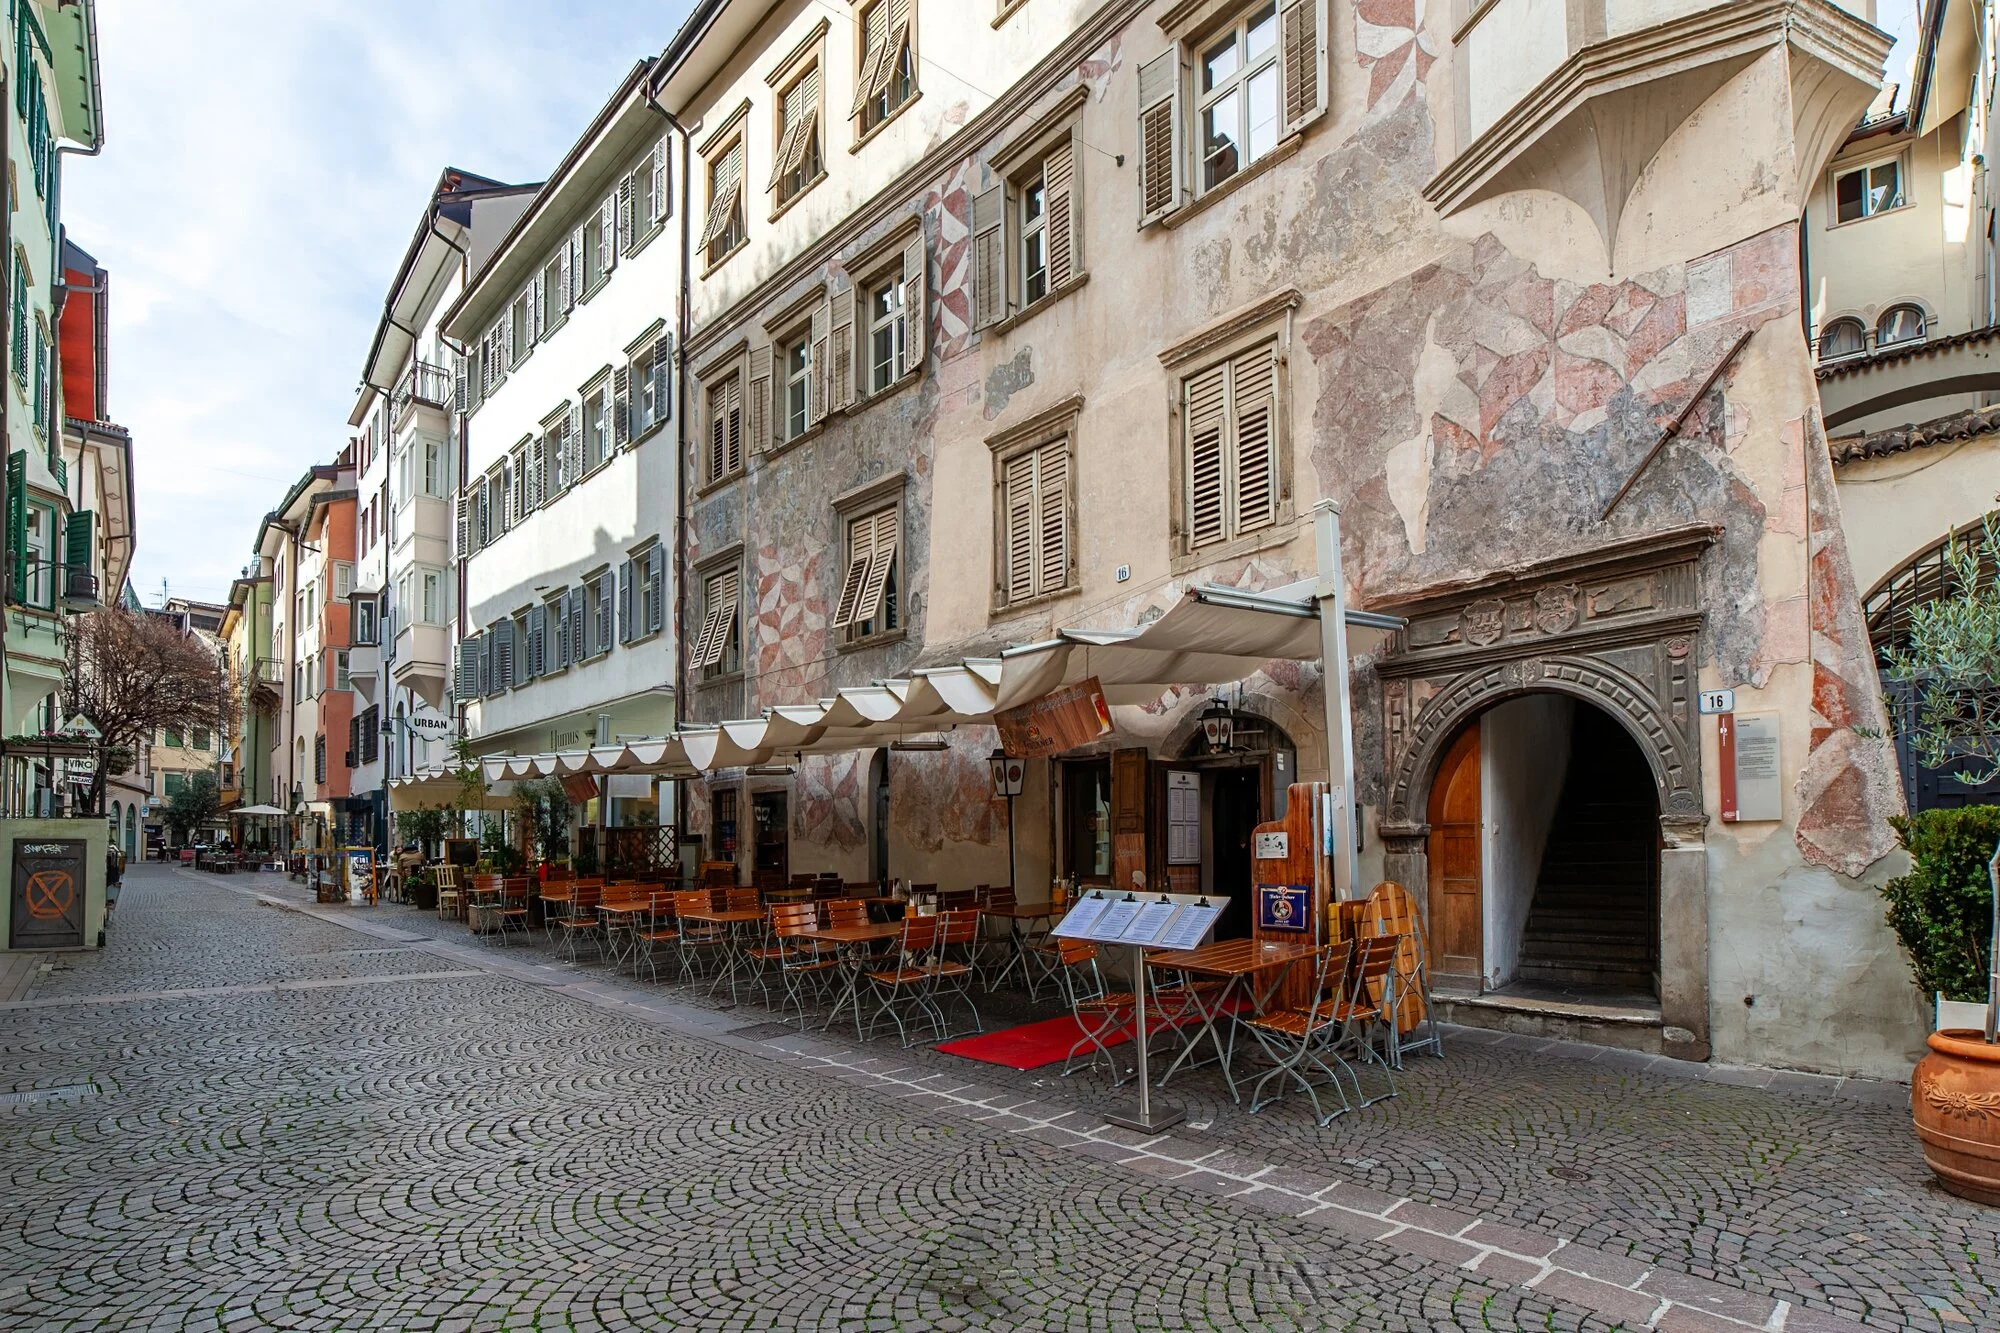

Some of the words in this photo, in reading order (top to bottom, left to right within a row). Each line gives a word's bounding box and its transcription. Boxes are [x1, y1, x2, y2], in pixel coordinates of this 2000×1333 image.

[1118, 567, 1127, 580] 16
[1709, 695, 1723, 708] 16
[414, 717, 448, 730] URBAN
[550, 729, 580, 752] Humus
[69, 759, 93, 770] VINO
